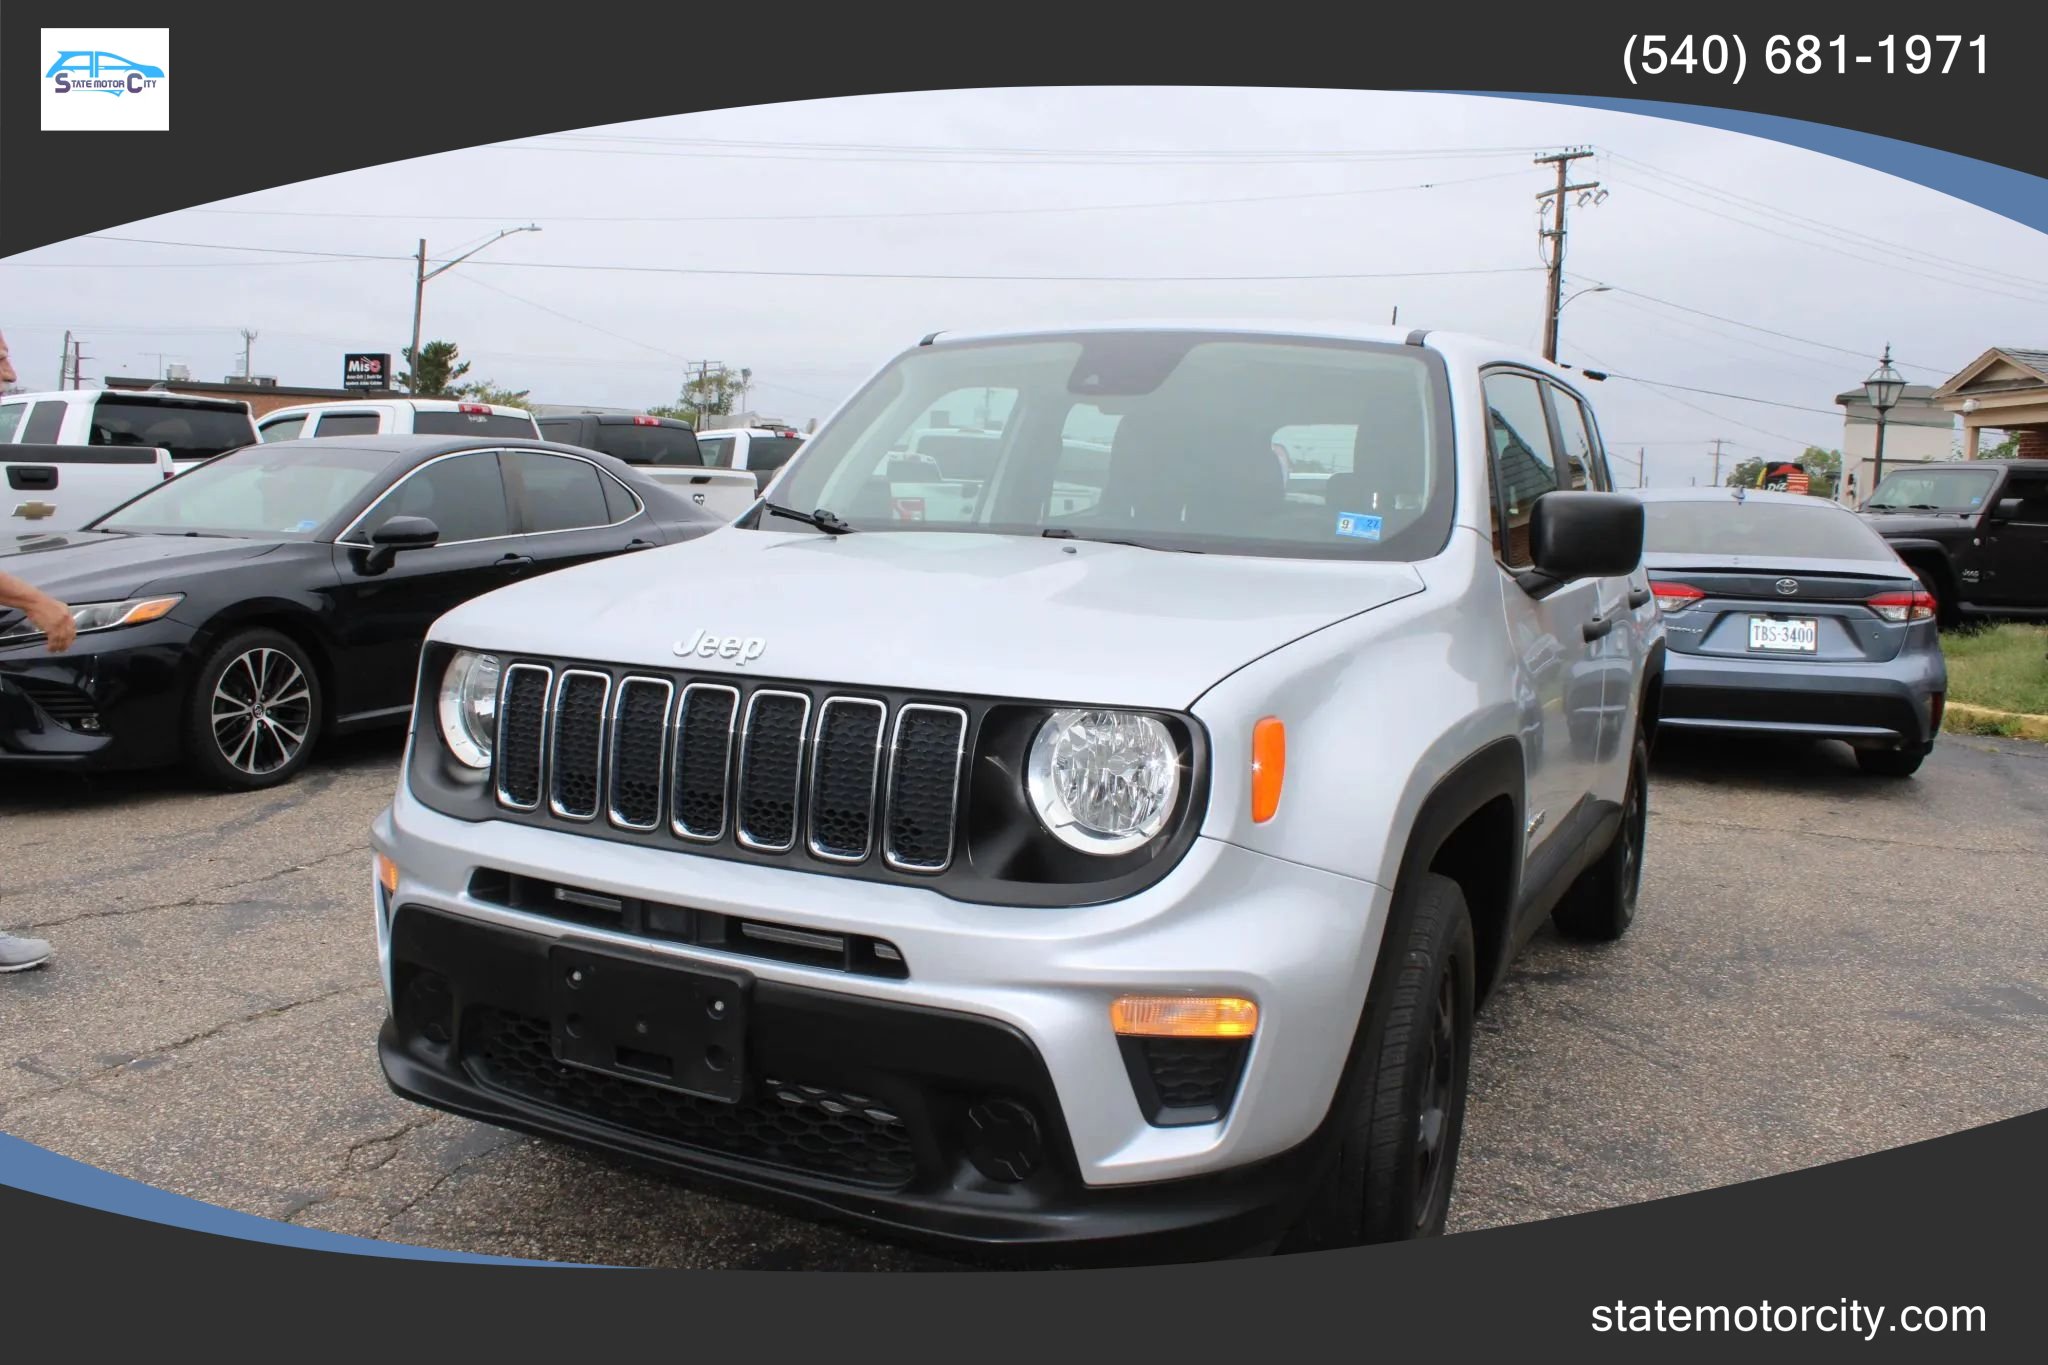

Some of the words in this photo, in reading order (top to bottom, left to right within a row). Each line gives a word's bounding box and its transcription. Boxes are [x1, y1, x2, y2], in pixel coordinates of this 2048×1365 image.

[1341, 519, 1350, 529] 9
[1753, 625, 1814, 643] TBS-3400
[672, 627, 766, 667] Jeep
